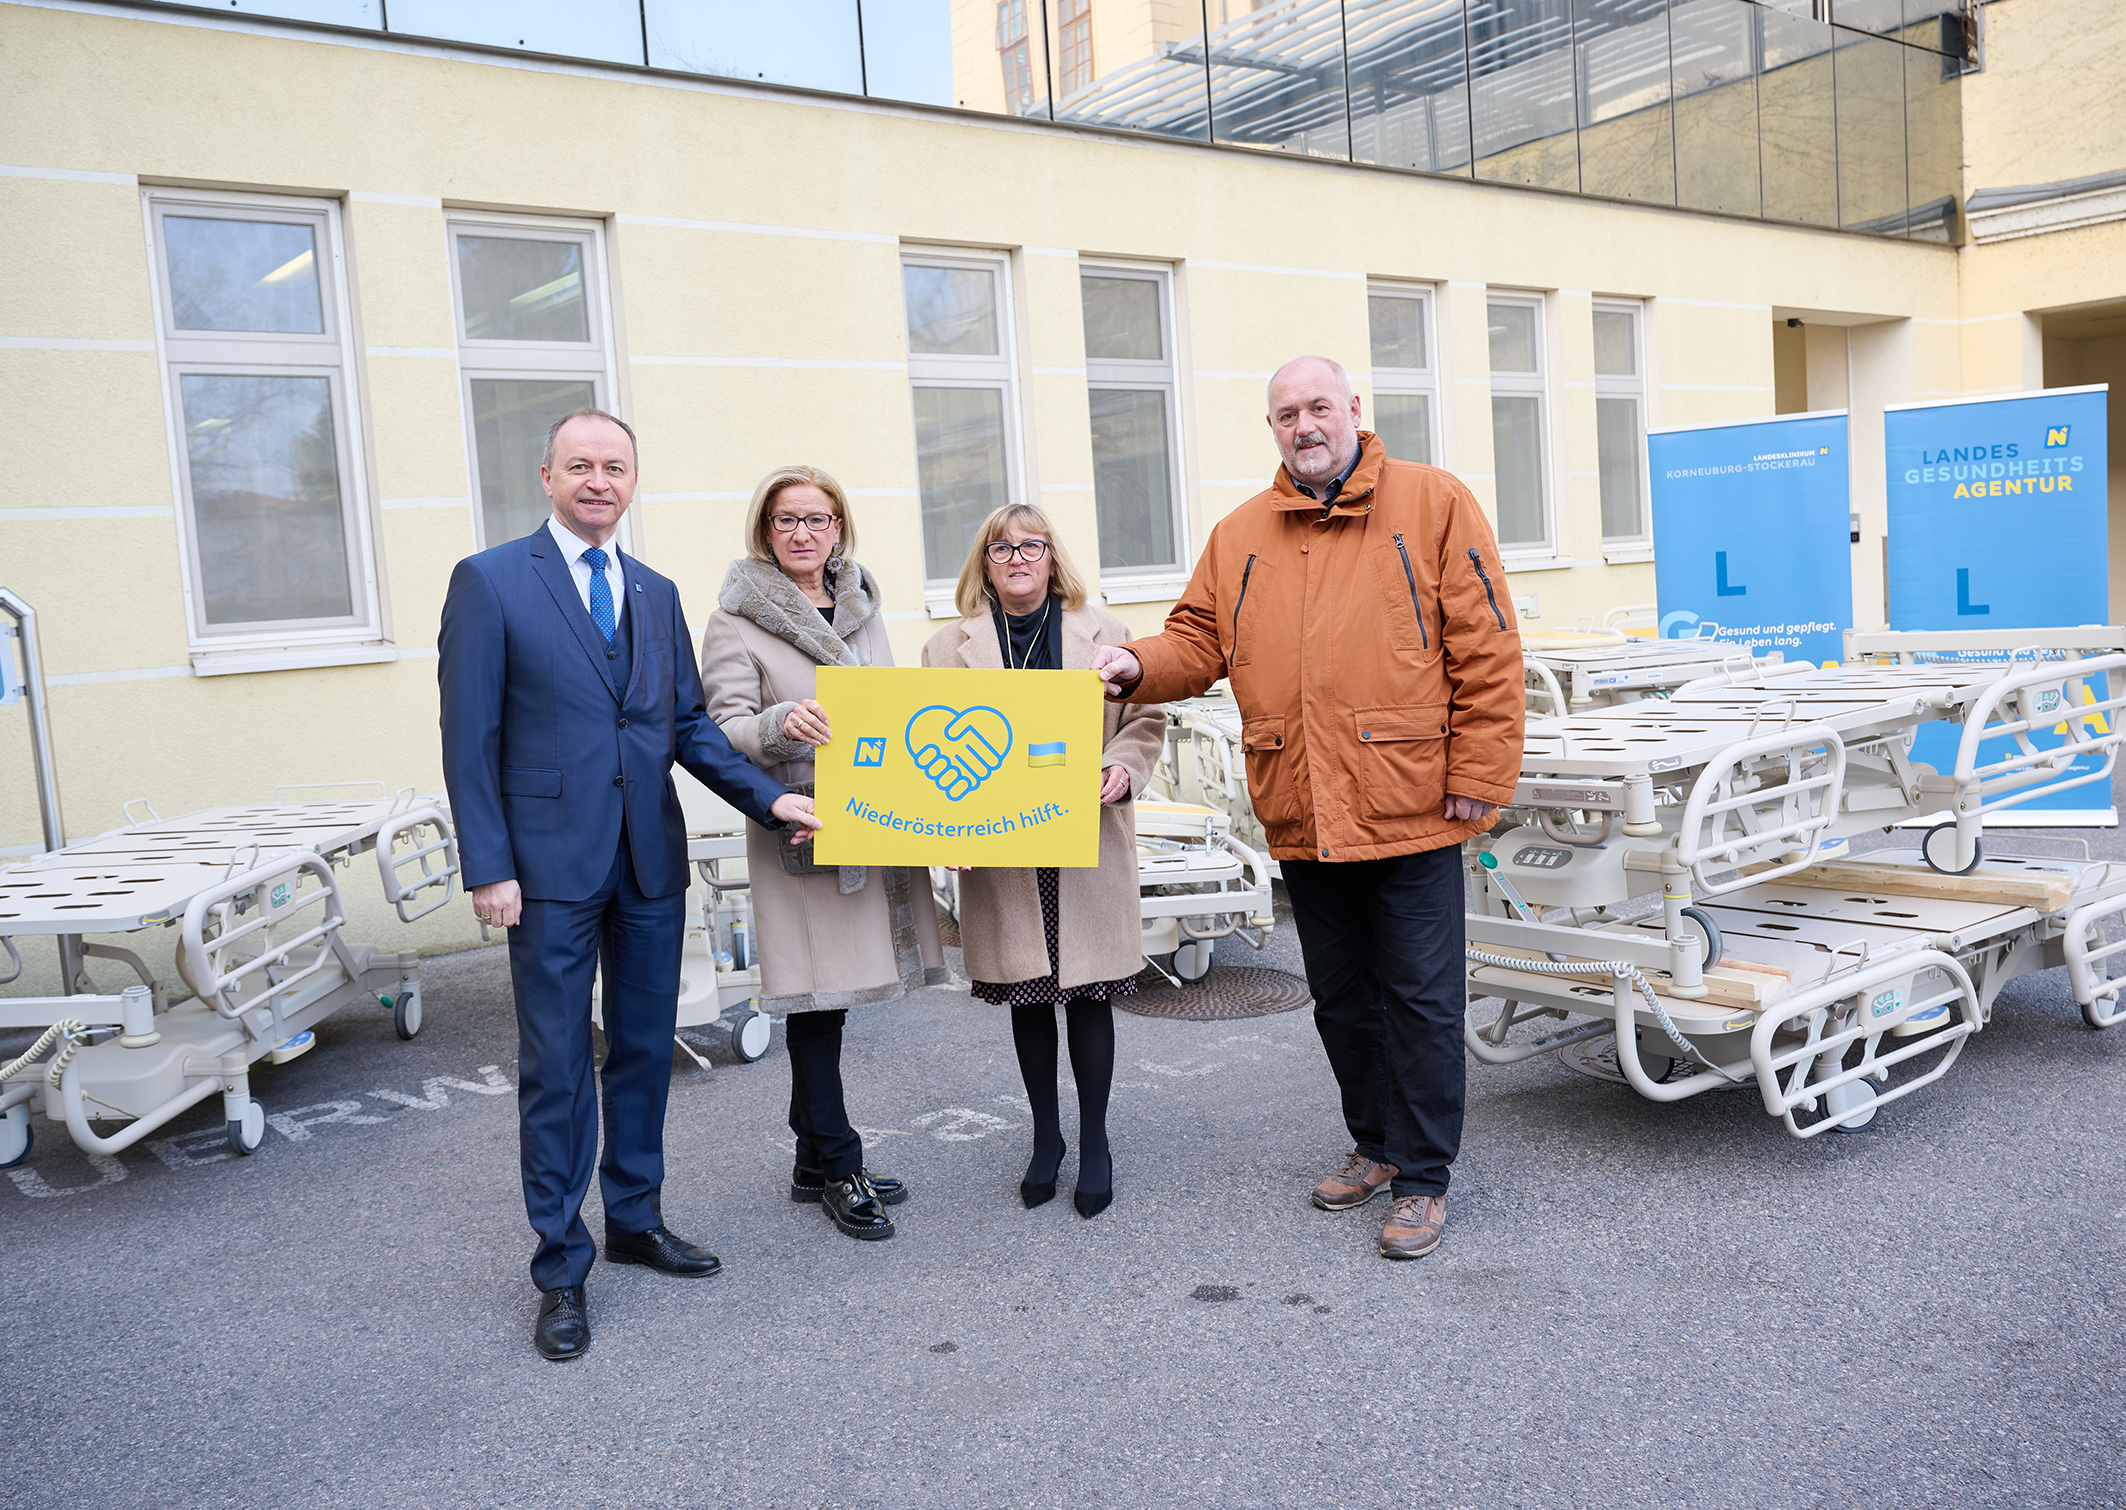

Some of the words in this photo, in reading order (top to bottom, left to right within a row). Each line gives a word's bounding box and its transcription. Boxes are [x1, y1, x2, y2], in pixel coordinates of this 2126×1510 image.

[1753, 449, 1815, 462] LANDESKLINIKUM
[1923, 443, 2019, 465] LANDES
[1666, 457, 1816, 479] KORNEUBURG-STOCKERAU
[1904, 455, 2084, 485] GESUNDHEITS
[1953, 475, 2073, 499] AGENTUR
[1715, 551, 1746, 597] L
[1956, 567, 1990, 616] L
[1718, 623, 1760, 637] Gesund
[1762, 622, 1785, 635] und
[1786, 621, 1837, 637] gepflegt.
[1738, 637, 1772, 647] Leben
[1774, 636, 1802, 648] lang.
[845, 797, 1016, 838] Niederösterreich
[1019, 801, 1070, 830] hilft.
